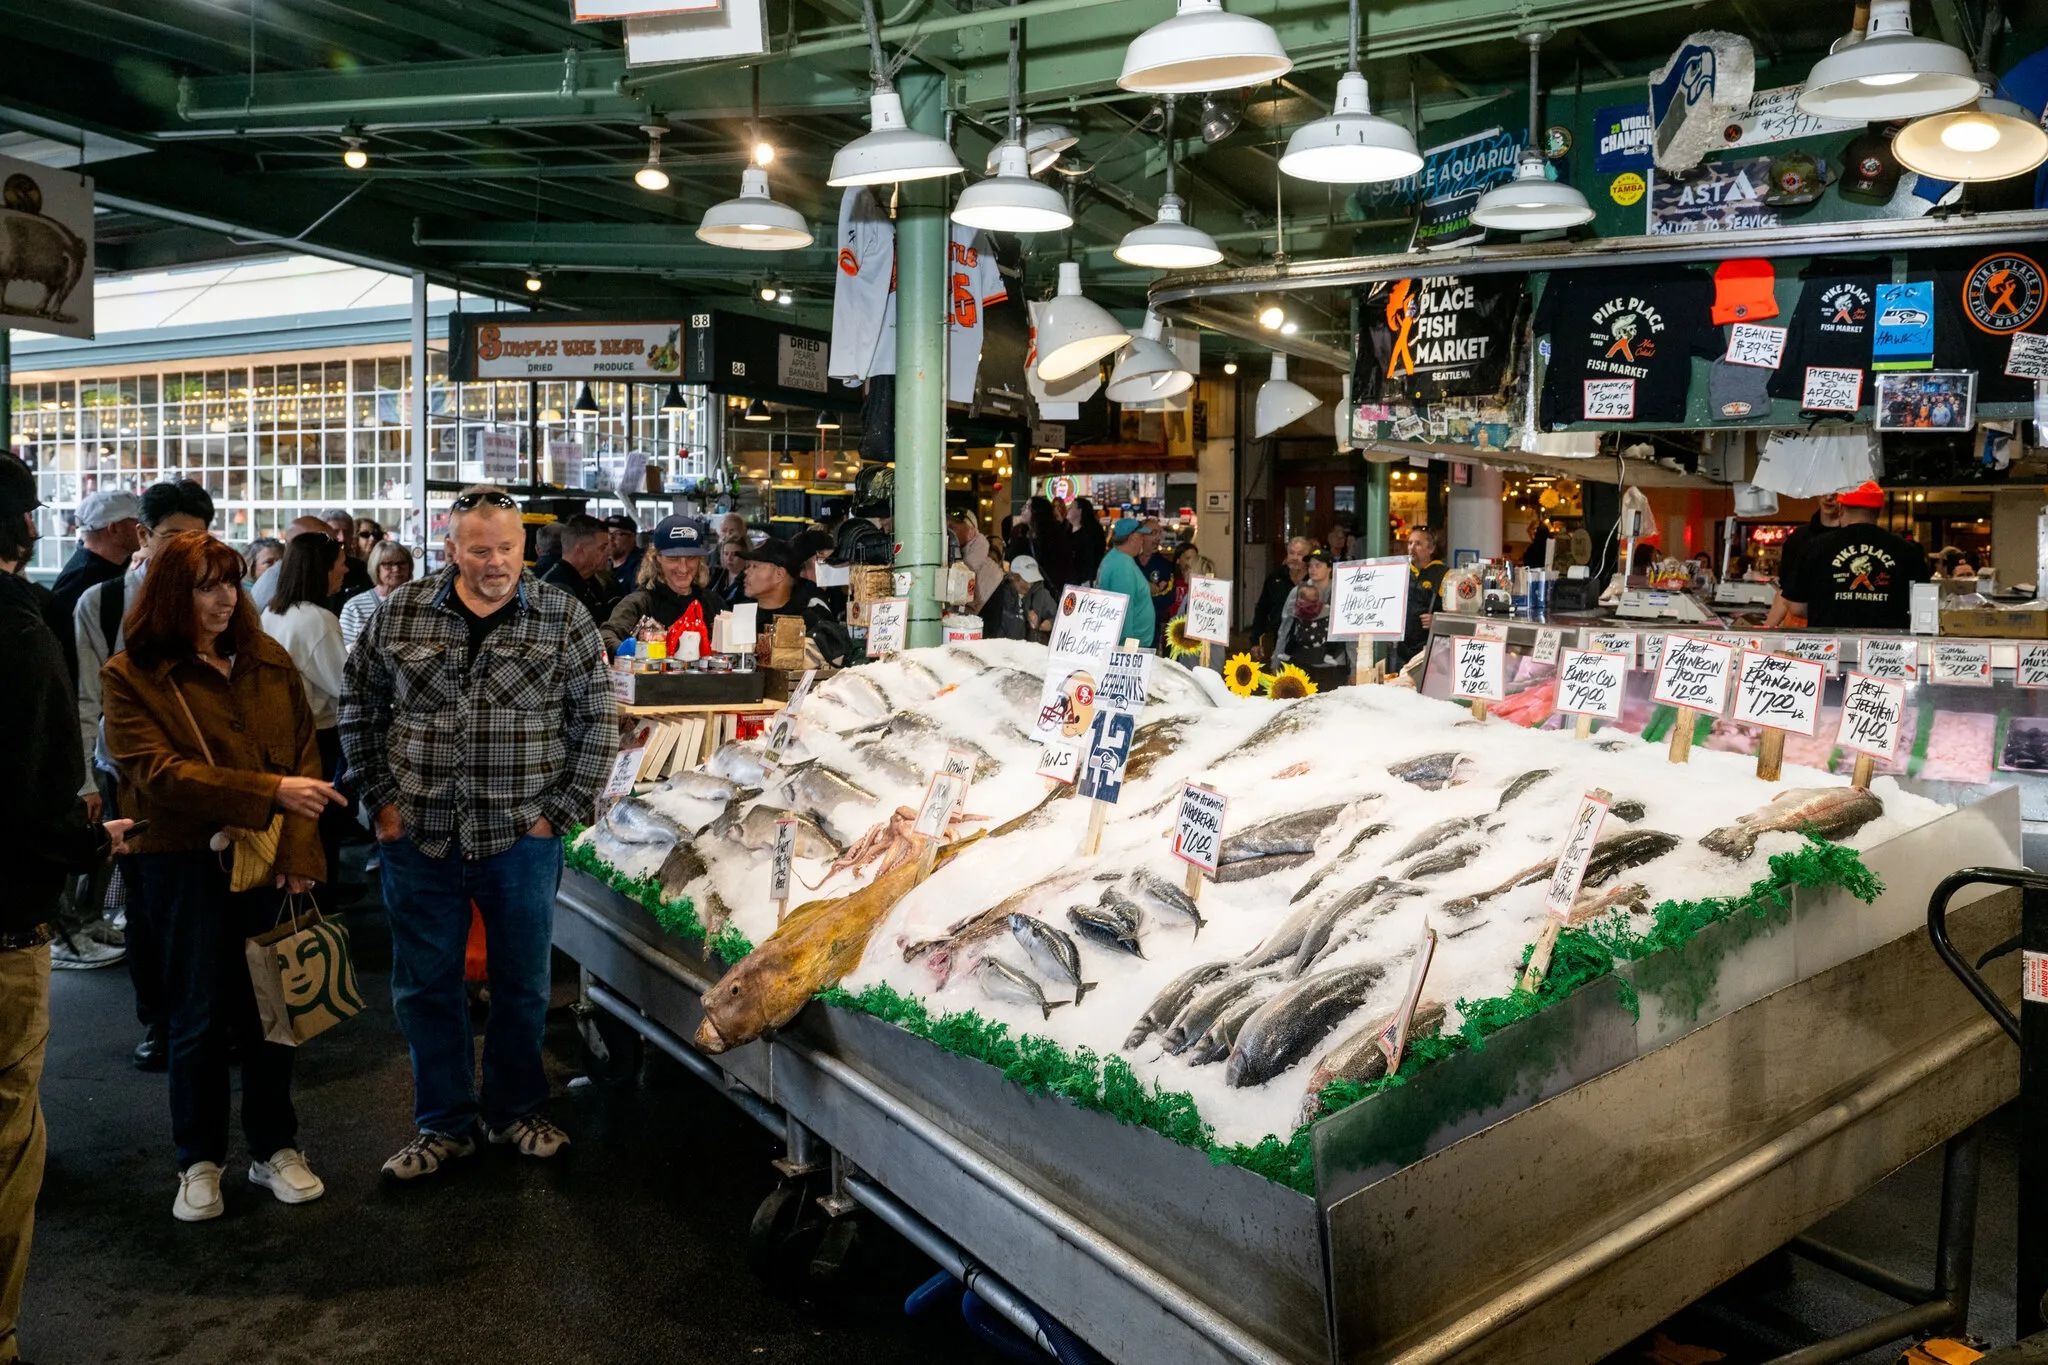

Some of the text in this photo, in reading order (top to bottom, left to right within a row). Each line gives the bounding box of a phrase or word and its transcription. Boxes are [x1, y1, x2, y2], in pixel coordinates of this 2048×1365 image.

[1612, 183, 1643, 194] TAMBA
[1651, 213, 1778, 236] SALUTE TO SERVICE
[1973, 260, 2039, 288] PIKE PLACE
[1419, 286, 1475, 315] PLACE
[1821, 283, 1871, 306] PIKE PLACE
[693, 315, 709, 327] 88
[1591, 297, 1665, 334] PIKE PLACE
[1972, 299, 2037, 327] FISH MARKET
[1417, 314, 1458, 340] FISH
[1734, 326, 1783, 344] BEANIE
[1820, 323, 1864, 334] FISH MARKET
[790, 337, 820, 353] DRIED
[1415, 336, 1490, 365] MARKET
[793, 351, 816, 361] PEARS
[527, 361, 635, 373] DRIED PRODUCE
[732, 362, 745, 375] 88
[788, 368, 820, 381] BANANAS
[791, 360, 817, 371] APPLES
[1586, 359, 1649, 379] FISH MARKET
[783, 376, 825, 390] VEGETABLES
[1806, 387, 1852, 399] APRON
[1831, 543, 1896, 569] PIKE PLACE
[1341, 594, 1395, 613] HALIBUT
[1835, 592, 1889, 602] FISH MARKET
[1078, 594, 1123, 621] PIKE PLACE
[1082, 617, 1105, 632] FISH
[1674, 639, 1714, 654] FRESH
[1132, 653, 1144, 668] GO
[1461, 653, 1486, 665] LING
[1570, 653, 1608, 667] FRESH
[1665, 648, 1725, 674] RAINBOW
[1464, 665, 1485, 679] COD
[1562, 665, 1617, 689] BLACK COD
[1664, 666, 1717, 684] TROUT
[1095, 673, 1145, 702] SEAHAWKS
[1078, 709, 1134, 804] 12
[1184, 786, 1224, 812] NORTH ATLANTIC
